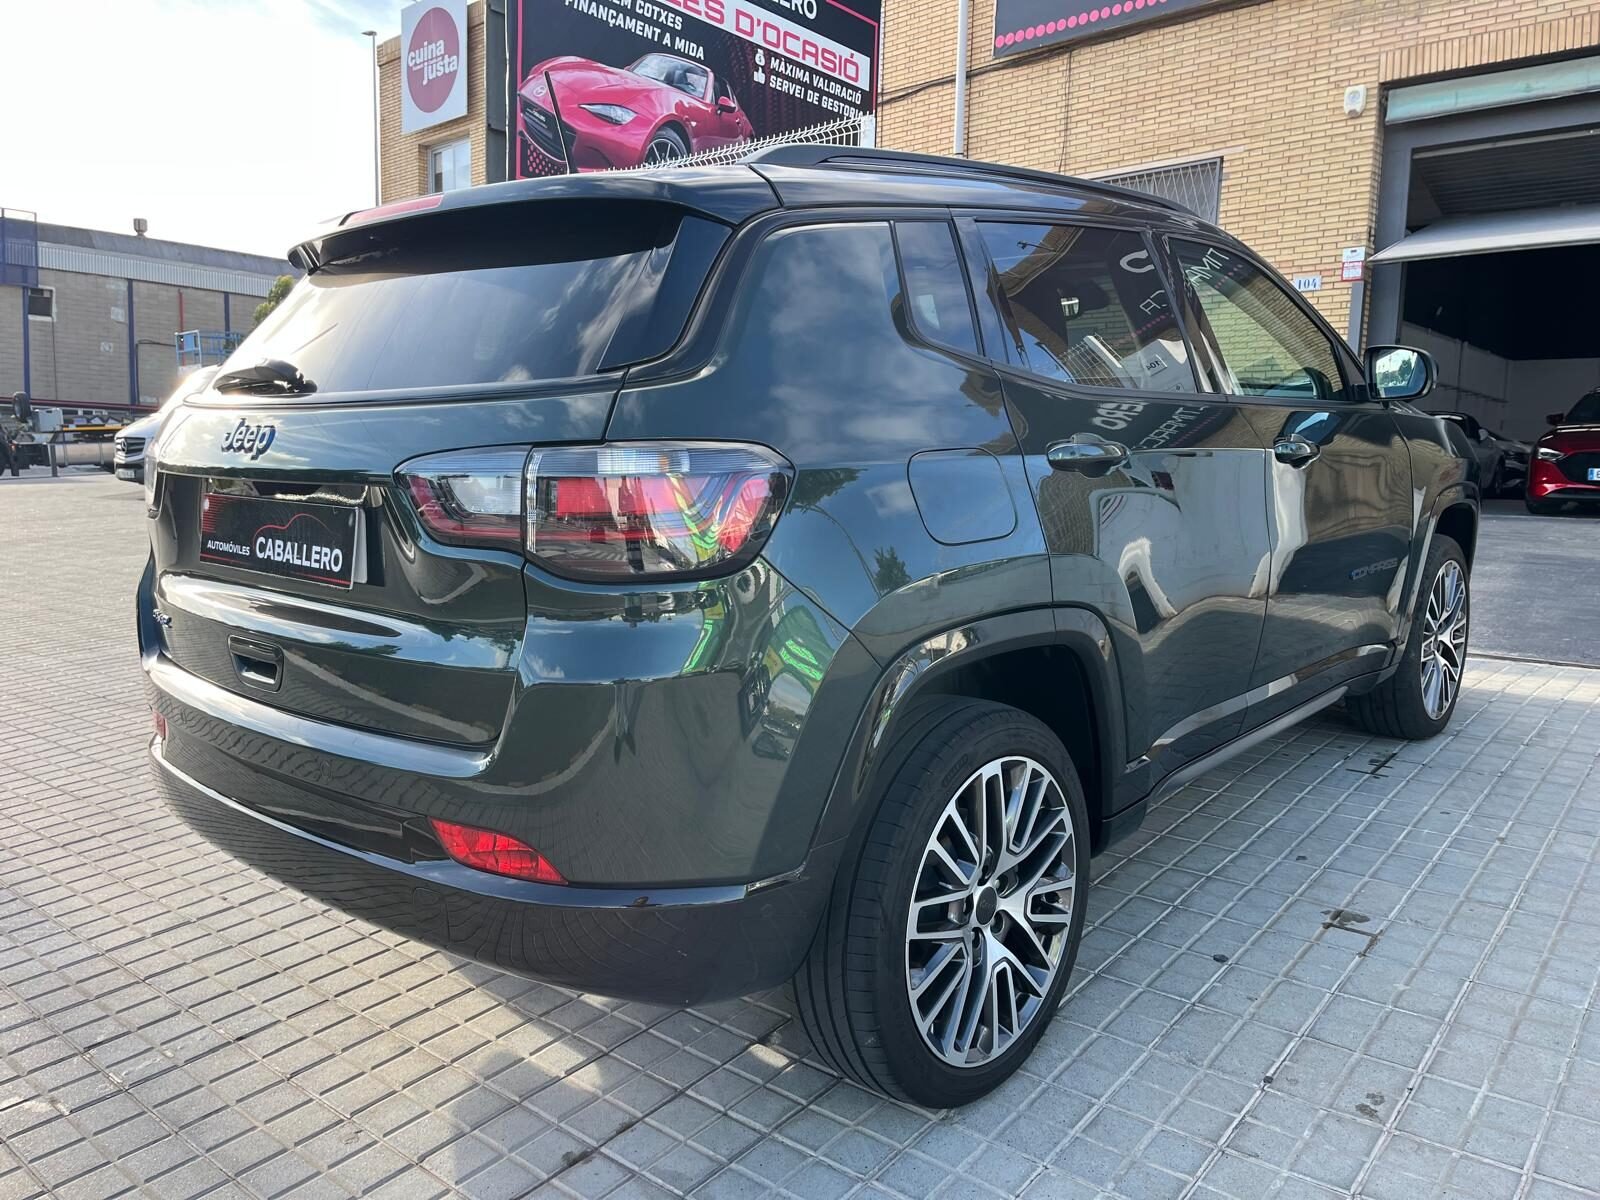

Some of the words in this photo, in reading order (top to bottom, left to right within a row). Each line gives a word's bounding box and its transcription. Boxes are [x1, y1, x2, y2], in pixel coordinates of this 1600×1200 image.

[635, 0, 683, 31] COTXES
[407, 39, 445, 68] cuina
[662, 32, 672, 48] A
[674, 36, 705, 61] MIDA
[735, 8, 860, 84] D'OCASIÓ
[422, 54, 458, 86] justa
[770, 56, 810, 84] MÀXIMA
[812, 73, 862, 105] VALORACIÓ
[769, 75, 805, 100] SERVEI
[806, 89, 820, 106] DE
[1298, 278, 1317, 290] 104
[221, 417, 276, 461] Jeep
[207, 539, 251, 556] AUTOMÓVILES
[255, 536, 343, 573] CABALLERO
